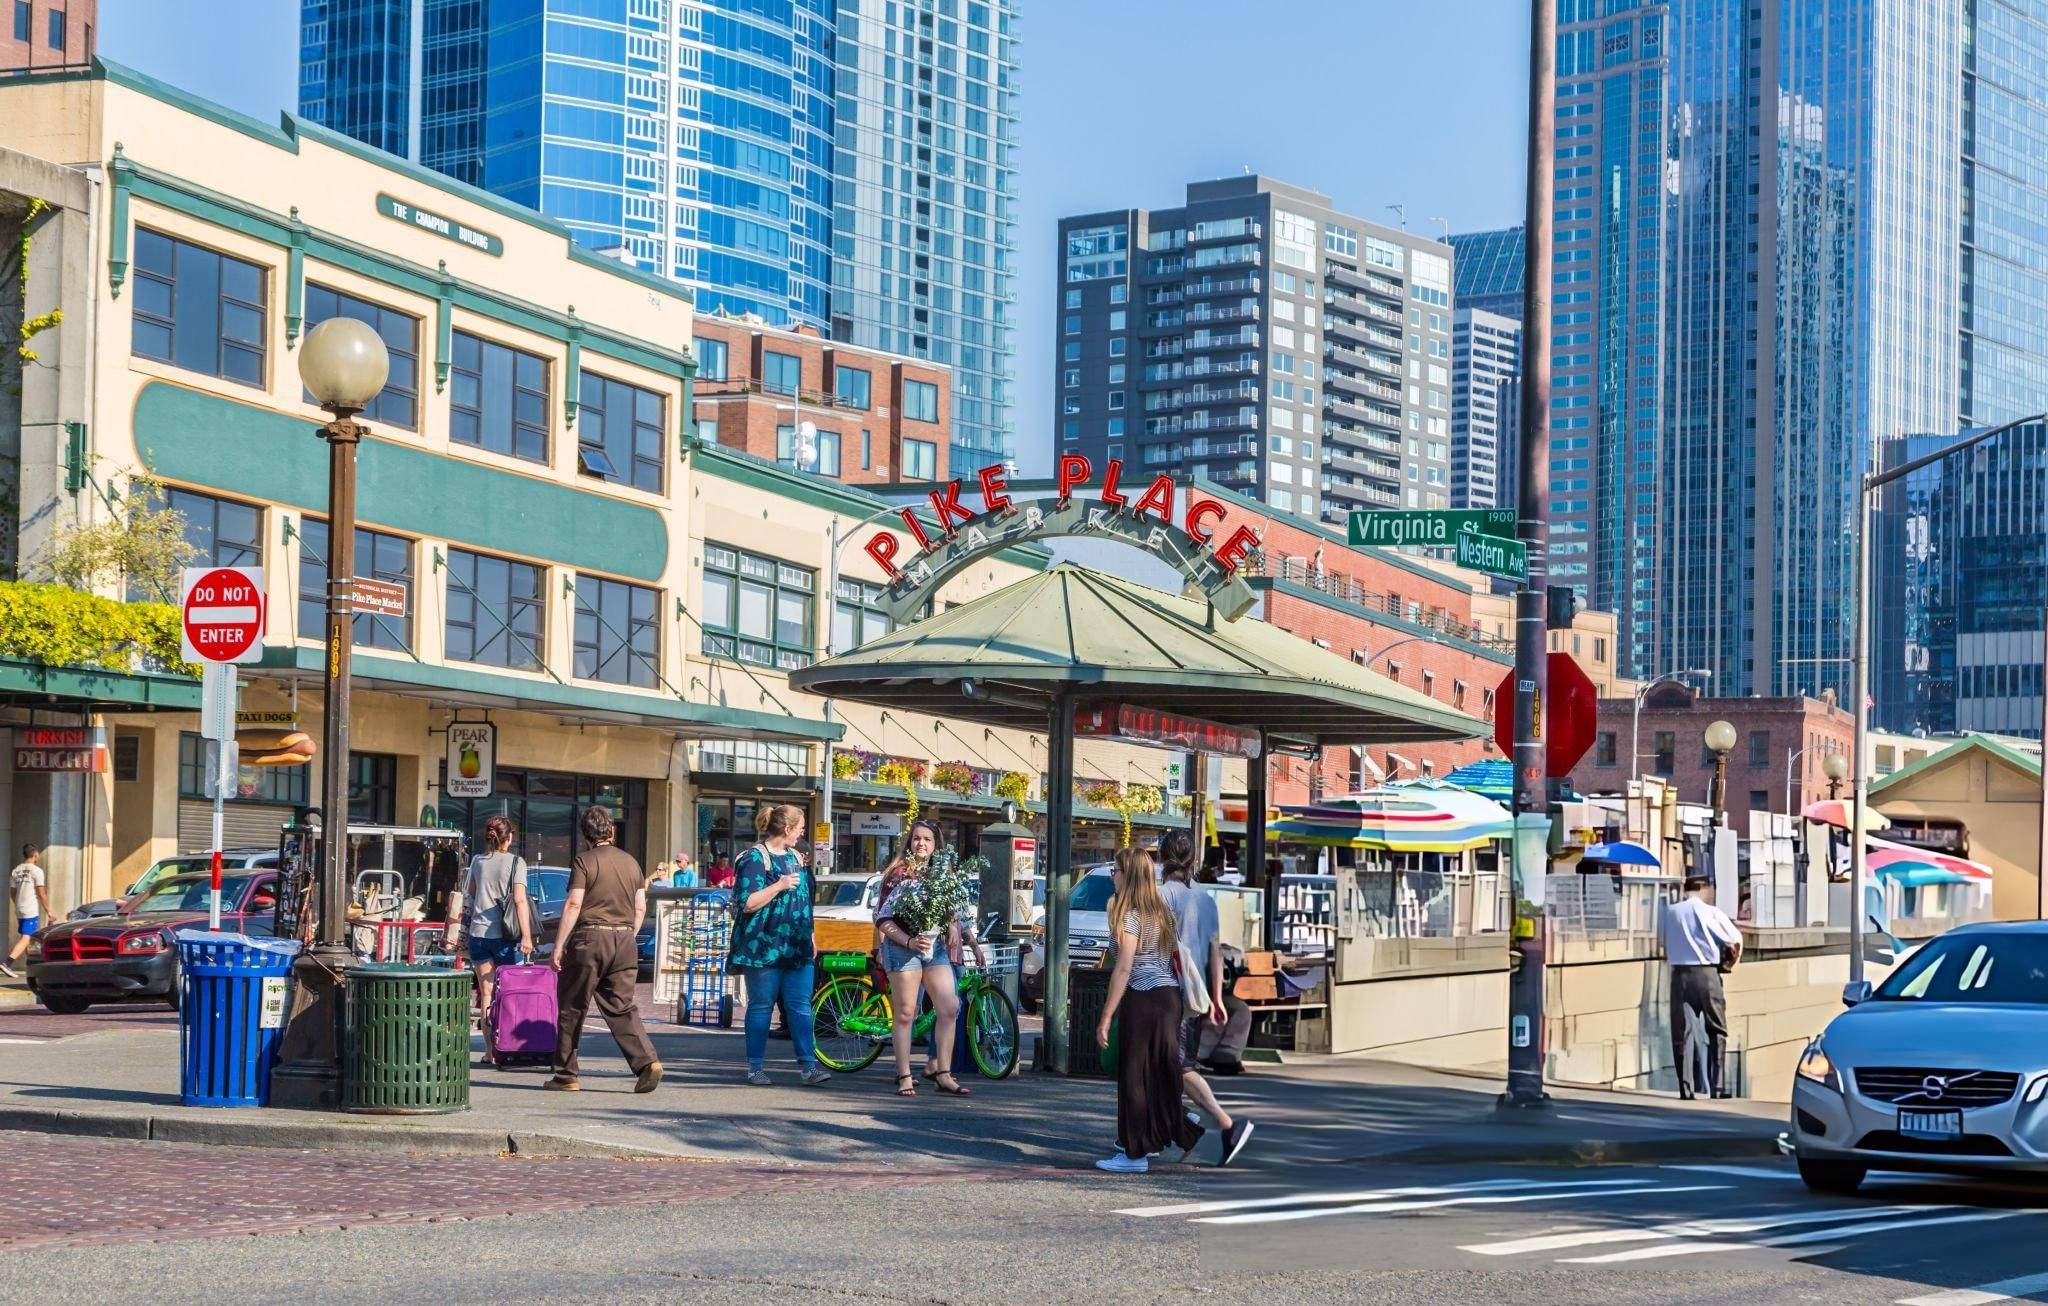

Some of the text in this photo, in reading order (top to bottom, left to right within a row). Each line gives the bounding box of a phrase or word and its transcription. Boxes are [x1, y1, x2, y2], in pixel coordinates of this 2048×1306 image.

[392, 202, 488, 249] THE CHAMPION BUILDING
[864, 456, 1260, 580] PIKE PLACE
[1489, 511, 1514, 523] 1900
[1357, 513, 1479, 544] Virginia St
[908, 506, 1219, 587] MARKET
[1459, 534, 1524, 573] Western Ave
[195, 587, 251, 602] DO NOT
[352, 592, 402, 609] Pike Place Market
[200, 628, 244, 643] ENTER
[238, 713, 292, 722] TAXI DOGS
[23, 729, 86, 745] TURKISH
[452, 729, 488, 742] PEAR
[18, 751, 92, 769] DELIGHT
